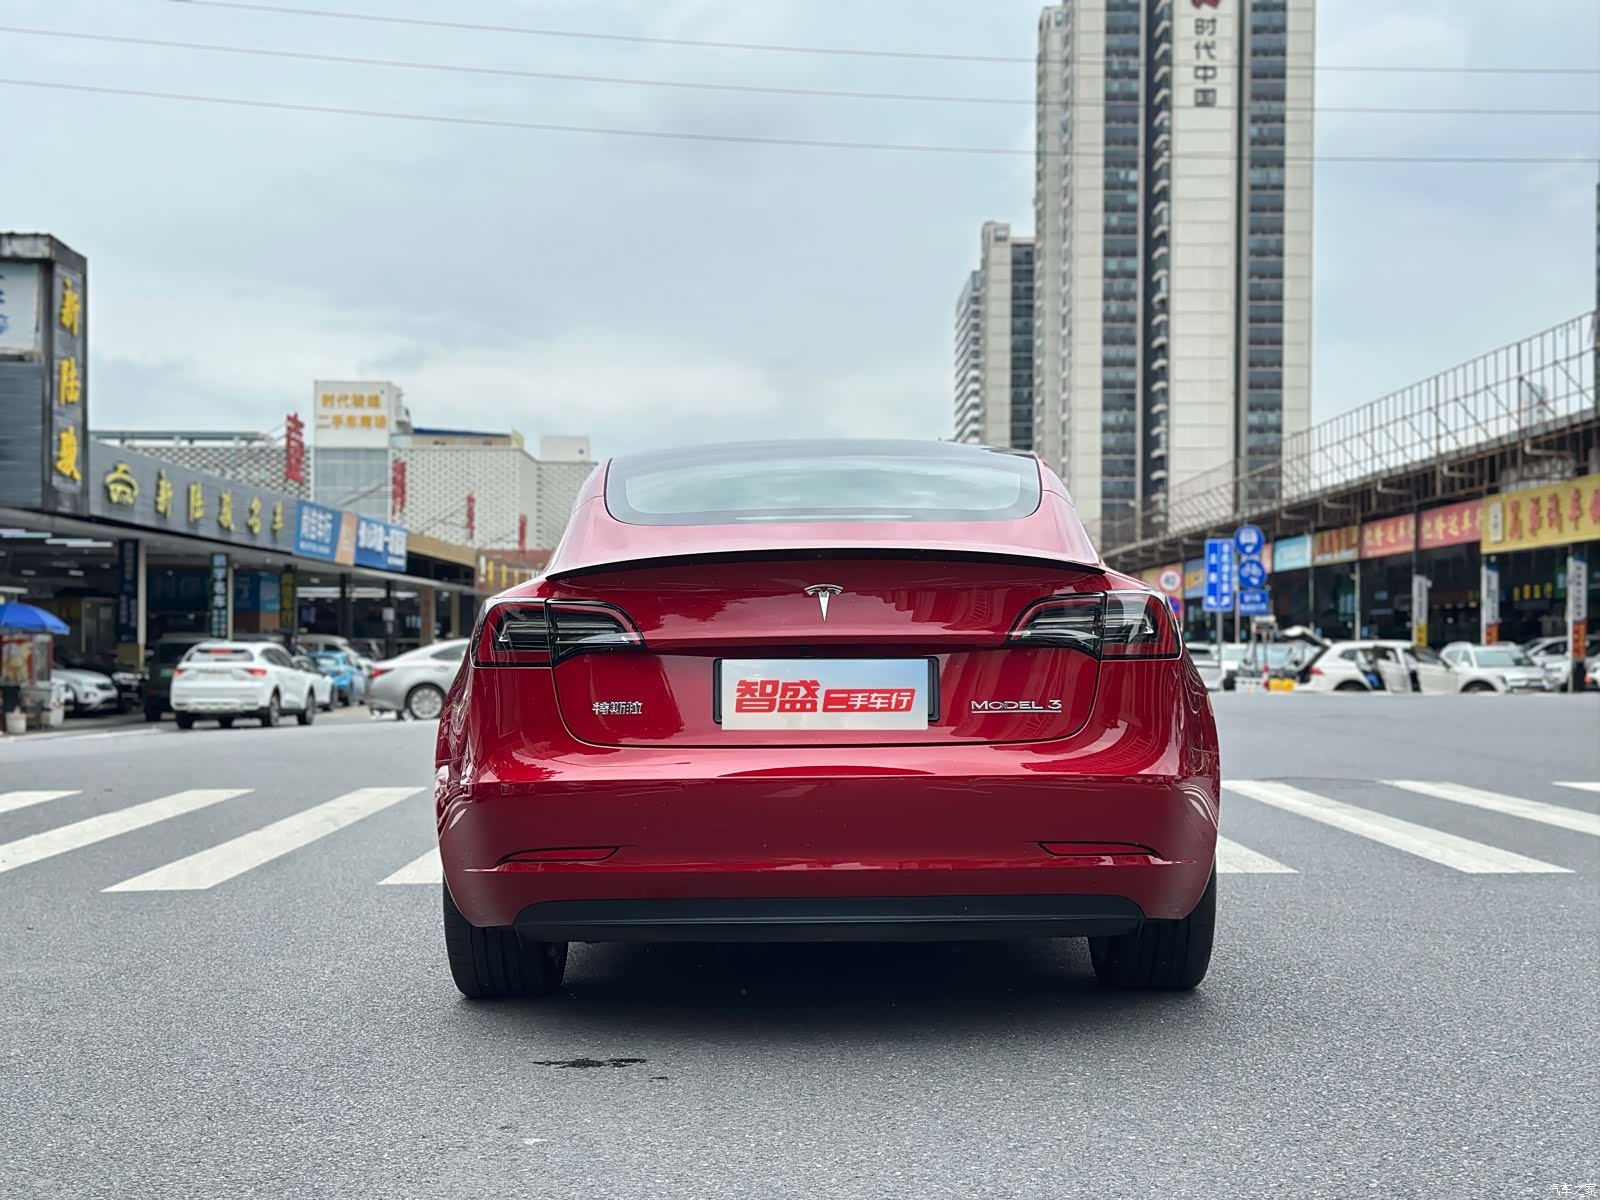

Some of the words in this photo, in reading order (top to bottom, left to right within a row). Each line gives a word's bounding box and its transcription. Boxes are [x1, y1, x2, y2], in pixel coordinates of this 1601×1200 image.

[1194, 18, 1217, 107] 时代中国
[592, 701, 643, 715] 特斯拉
[735, 680, 821, 713] 智盛
[826, 691, 912, 710] 二手车行
[971, 700, 1043, 710] MODEL
[1048, 700, 1062, 710] 3
